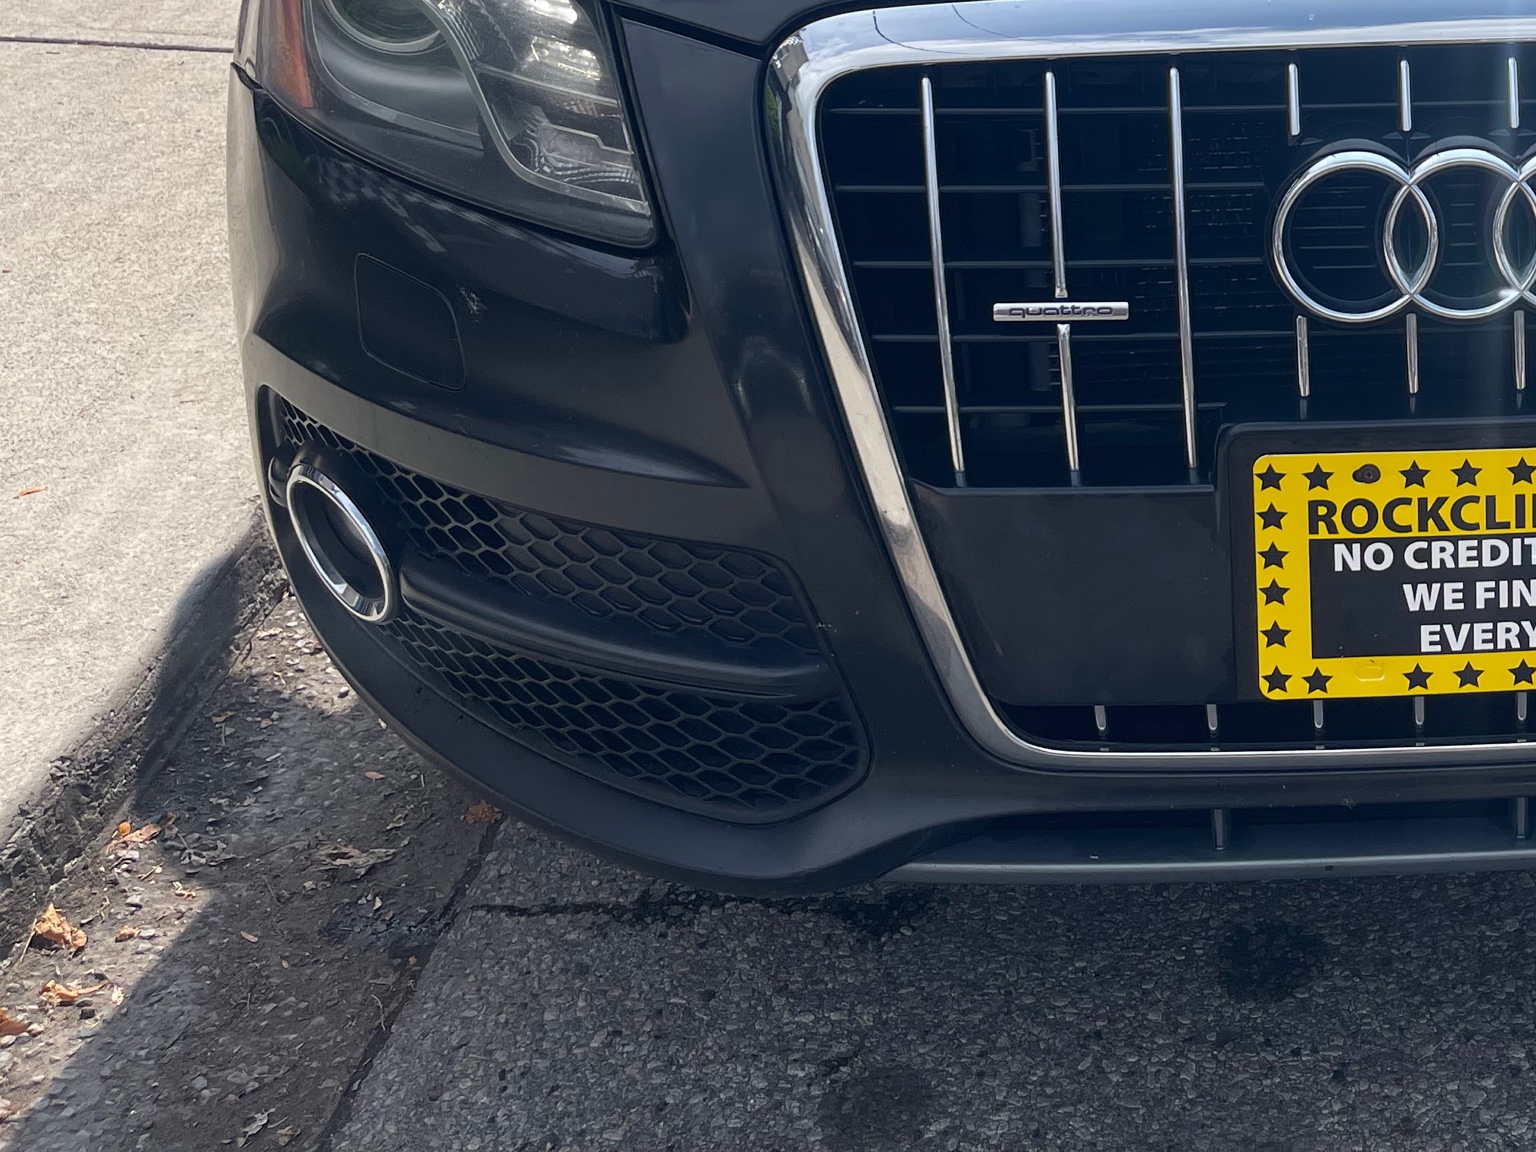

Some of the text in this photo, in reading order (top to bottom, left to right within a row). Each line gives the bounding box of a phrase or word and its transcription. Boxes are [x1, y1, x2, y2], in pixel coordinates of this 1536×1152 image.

[1009, 304, 1115, 318] quattro
[1333, 541, 1395, 572] NO
[1402, 581, 1465, 611] WE
